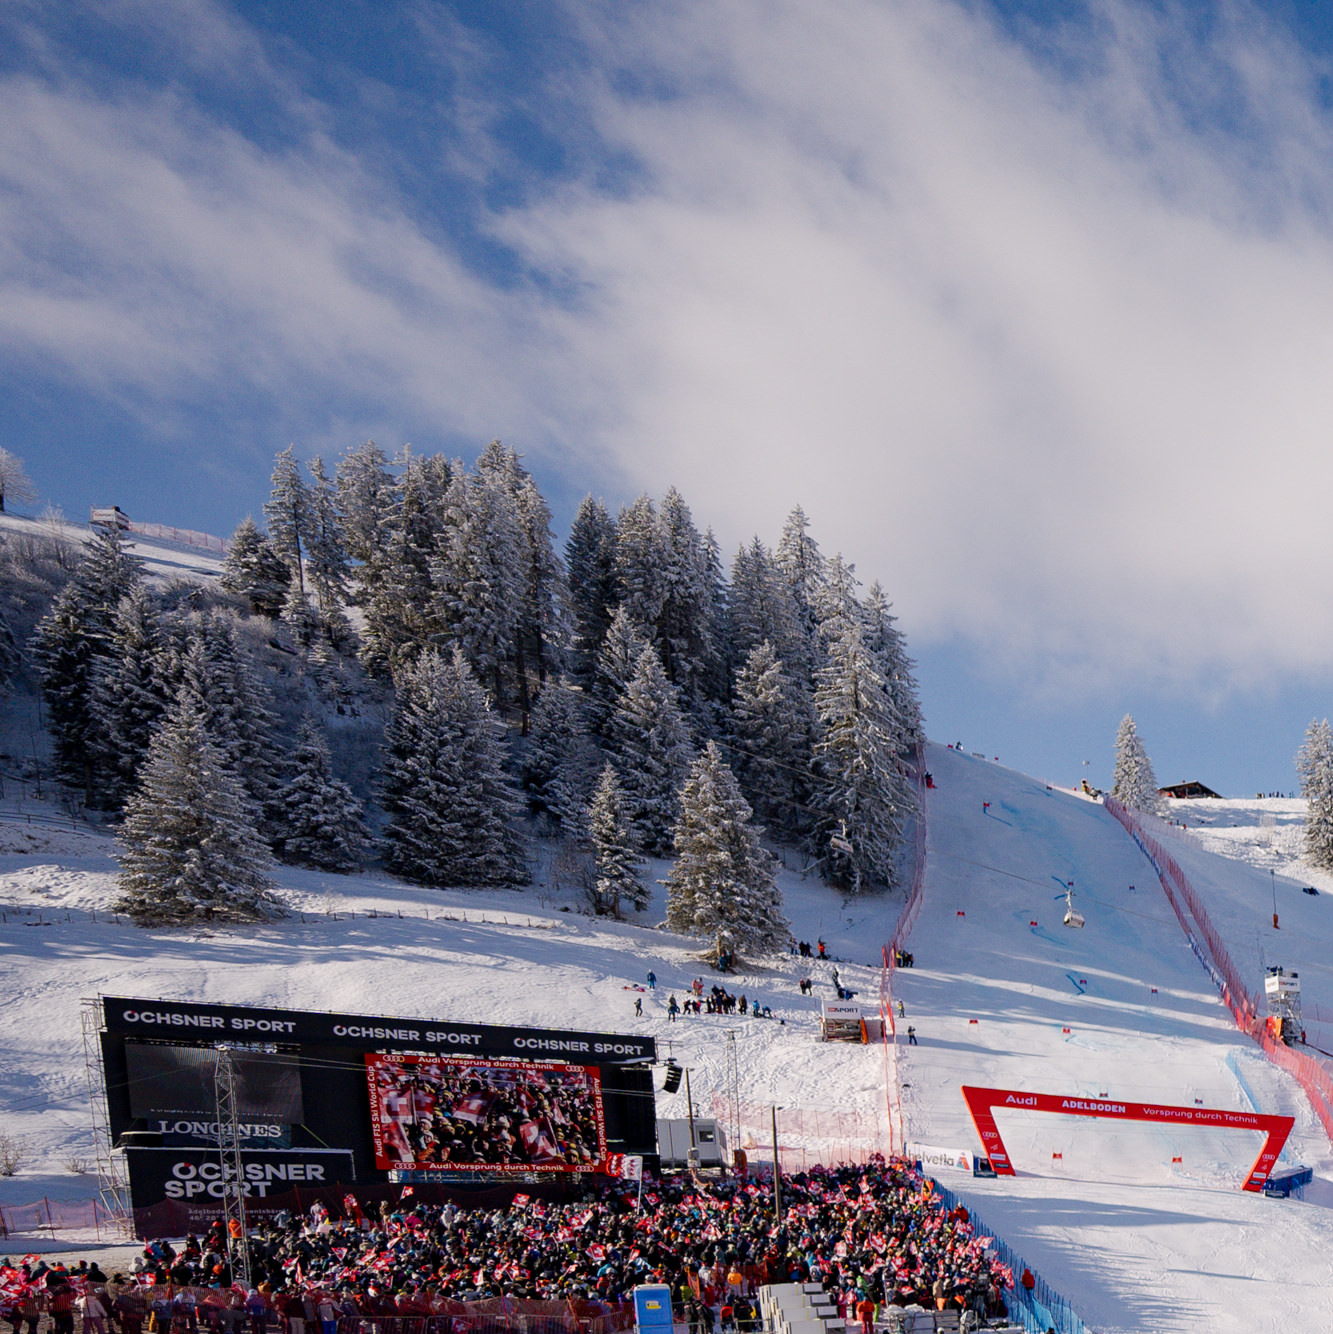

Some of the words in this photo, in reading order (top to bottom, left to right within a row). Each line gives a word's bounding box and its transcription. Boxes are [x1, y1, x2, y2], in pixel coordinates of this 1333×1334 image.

[123, 1010, 225, 1028] OCHSNER
[231, 1018, 296, 1033] SPORT
[333, 1025, 420, 1041] OCHSNER
[425, 1031, 482, 1045] SPORT
[513, 1037, 590, 1052] OCHSNER
[594, 1042, 644, 1056] SPORT
[418, 1056, 441, 1064] Audi
[443, 1058, 491, 1068] Vorsprung
[493, 1060, 518, 1068] durch
[521, 1062, 554, 1070] Technik
[367, 1066, 376, 1084] Cup
[370, 1085, 379, 1109] World
[1005, 1094, 1037, 1106] Audi
[1062, 1100, 1126, 1113] ADELBODEN
[1143, 1107, 1192, 1118] Vorsprung
[1195, 1111, 1221, 1120] durch
[1224, 1114, 1258, 1124] Technik
[158, 1120, 282, 1138] LONGINES
[375, 1141, 383, 1157] Audi
[908, 1149, 954, 1166] helvetia
[172, 1162, 326, 1181] OCHSNER
[453, 1163, 501, 1172] Vorsprung
[165, 1180, 272, 1198] SPORT
